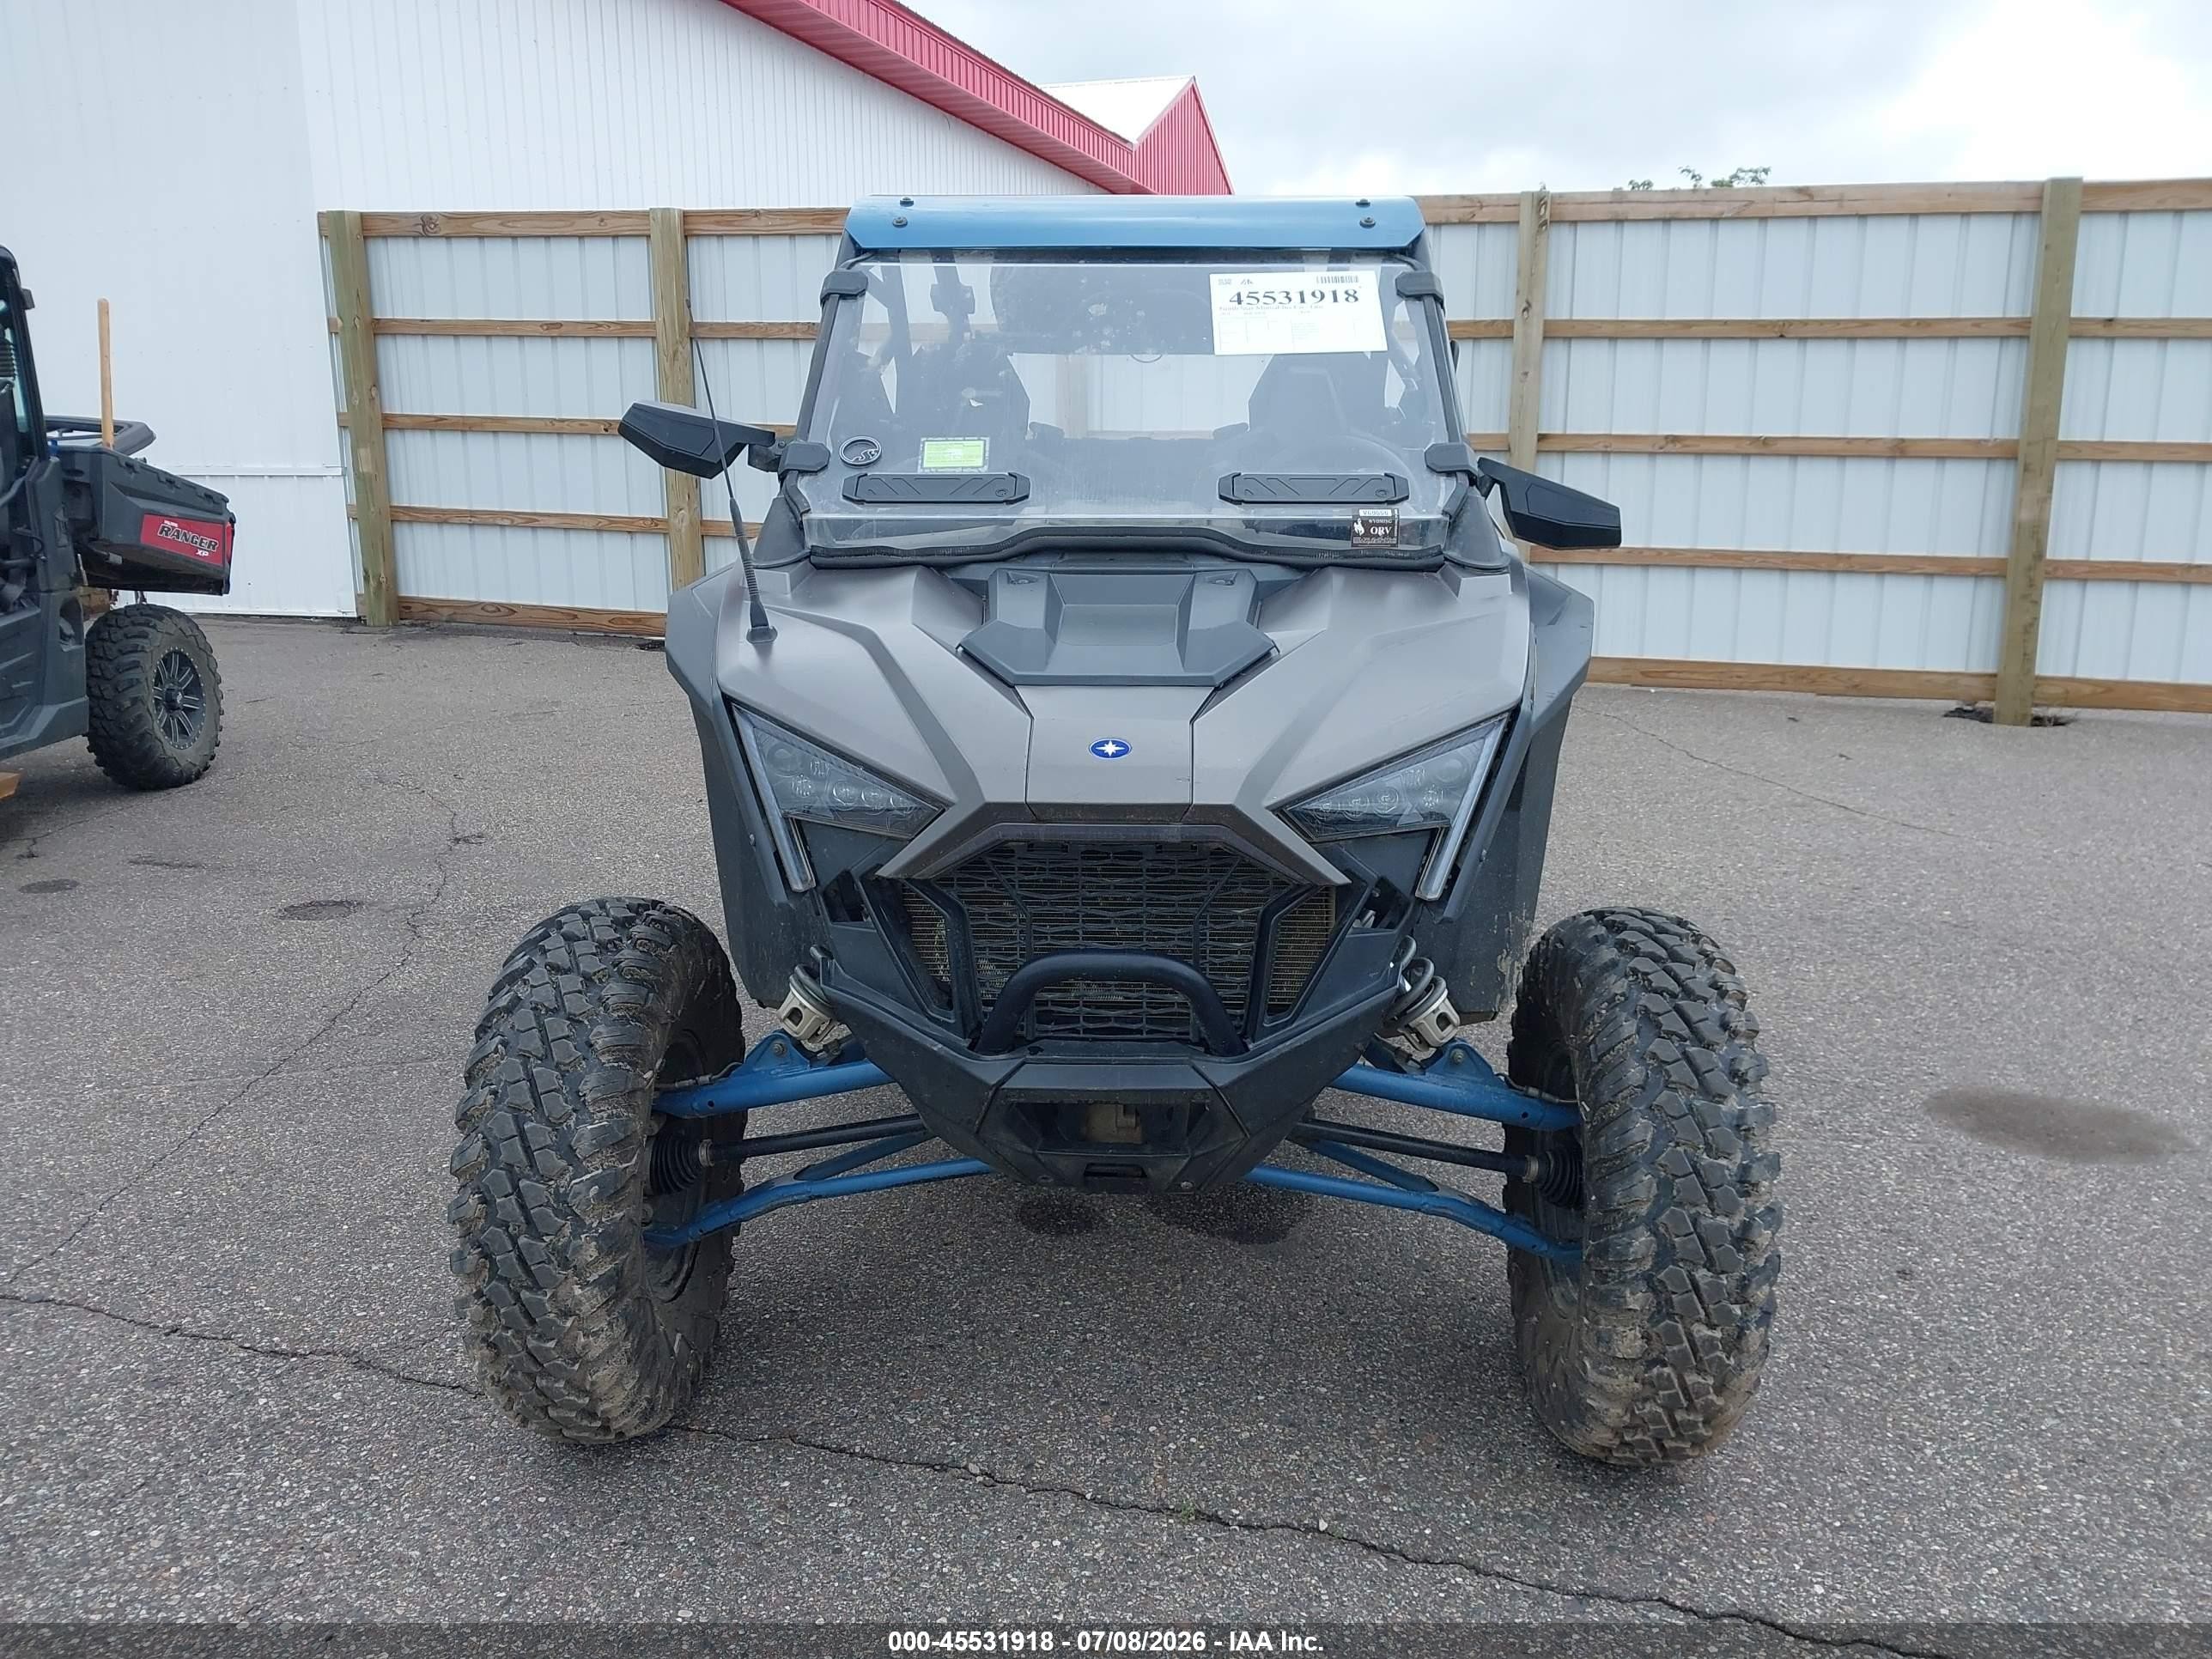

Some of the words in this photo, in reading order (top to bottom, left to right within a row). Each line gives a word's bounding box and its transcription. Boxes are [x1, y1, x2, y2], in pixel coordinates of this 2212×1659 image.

[1229, 289, 1359, 306] 45531918
[1370, 526, 1392, 536] ORV
[157, 524, 219, 552] RANGER
[196, 549, 210, 557] XP
